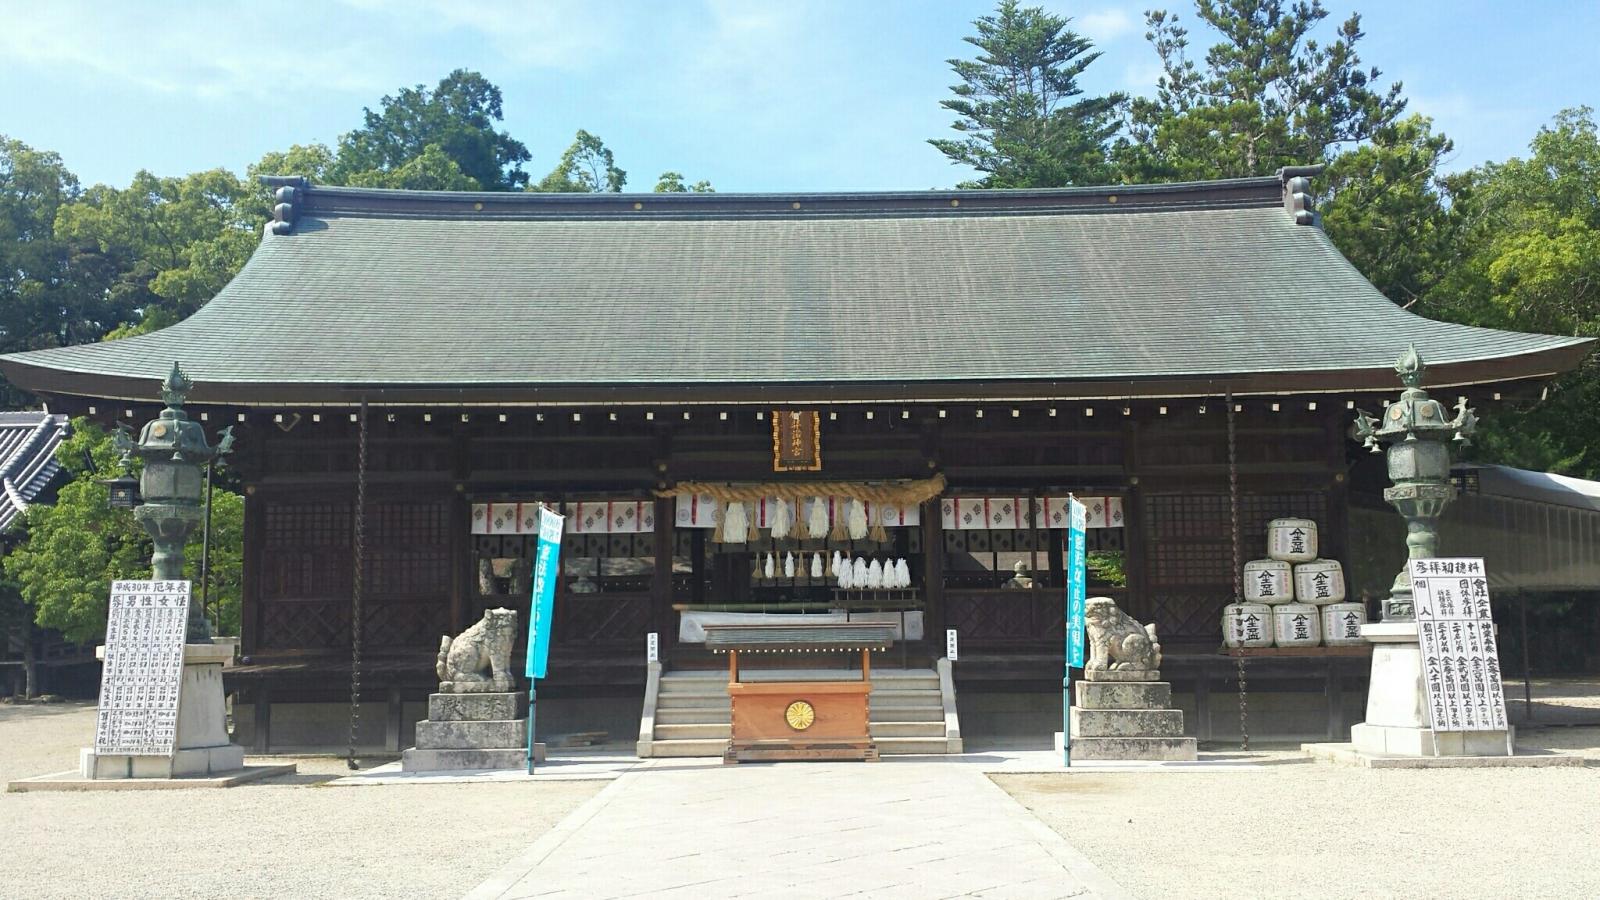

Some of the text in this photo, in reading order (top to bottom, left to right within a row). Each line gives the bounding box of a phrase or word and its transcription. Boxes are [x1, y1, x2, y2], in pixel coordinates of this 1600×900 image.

[1289, 528, 1305, 554] 金盃
[153, 582, 187, 593] 厄年表
[1258, 570, 1276, 597] 金盃
[1312, 572, 1330, 598] 金盃
[126, 595, 153, 606] 男性
[158, 595, 186, 606] 女性
[1244, 613, 1261, 640] 金盃
[1292, 613, 1309, 640] 金盃
[1343, 612, 1359, 638] 金盃
